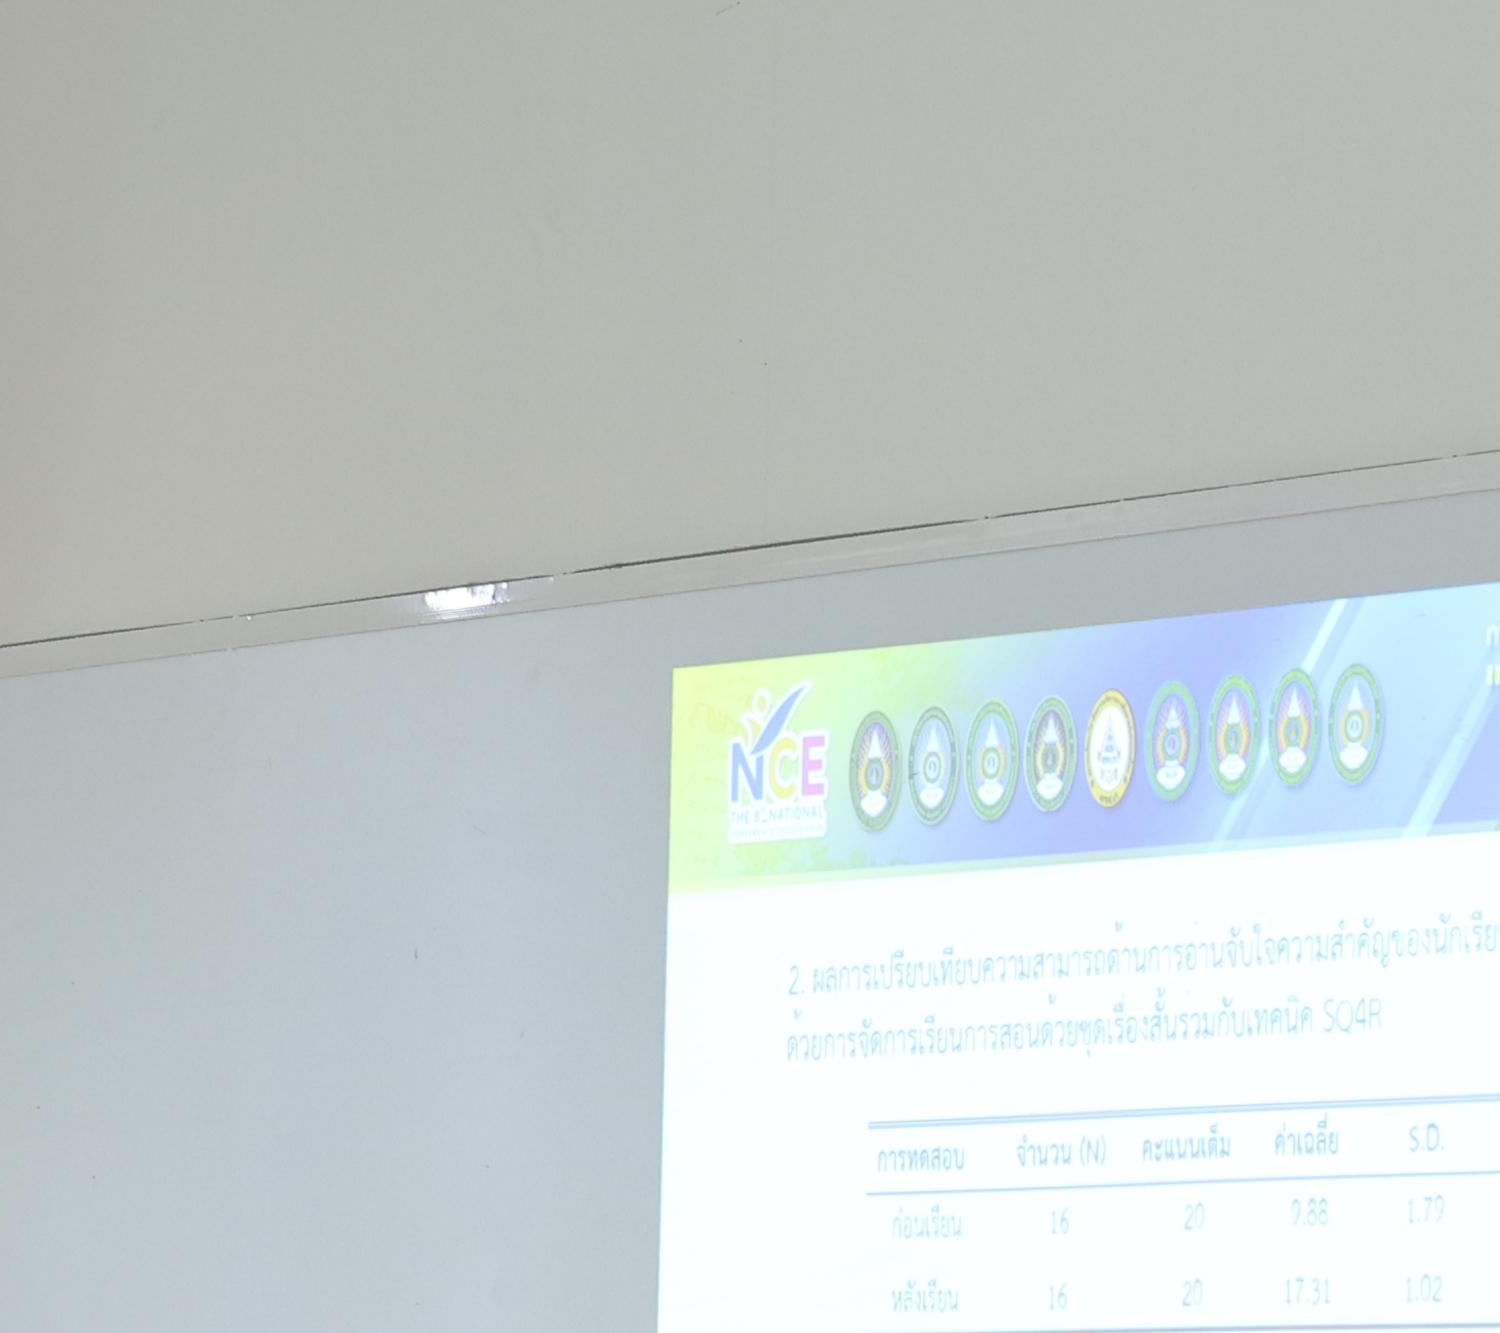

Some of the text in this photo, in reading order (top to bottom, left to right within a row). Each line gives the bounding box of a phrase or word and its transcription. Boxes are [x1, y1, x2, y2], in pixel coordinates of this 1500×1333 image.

[731, 736, 825, 803] NCE
[788, 964, 809, 996] 2.
[1323, 997, 1380, 1035] SQ4R
[876, 1144, 965, 1173] การทดสอบ
[1015, 1134, 1072, 1168] จำนวน
[1079, 1134, 1108, 1167] (N)
[1141, 1120, 1232, 1161] คะแนนเต็ม
[1273, 1112, 1339, 1158] ค่าเฉลี่ย
[1408, 1122, 1445, 1153] S.D.
[891, 1204, 963, 1241] ก่อนเรียน
[1049, 1207, 1070, 1236] 16
[1182, 1201, 1206, 1233] 20
[1290, 1198, 1329, 1229] 9.88
[890, 1278, 961, 1314] หลังเรียน
[1047, 1281, 1069, 1312] 16
[1181, 1278, 1204, 1309] 20
[1284, 1277, 1332, 1307] 17.31
